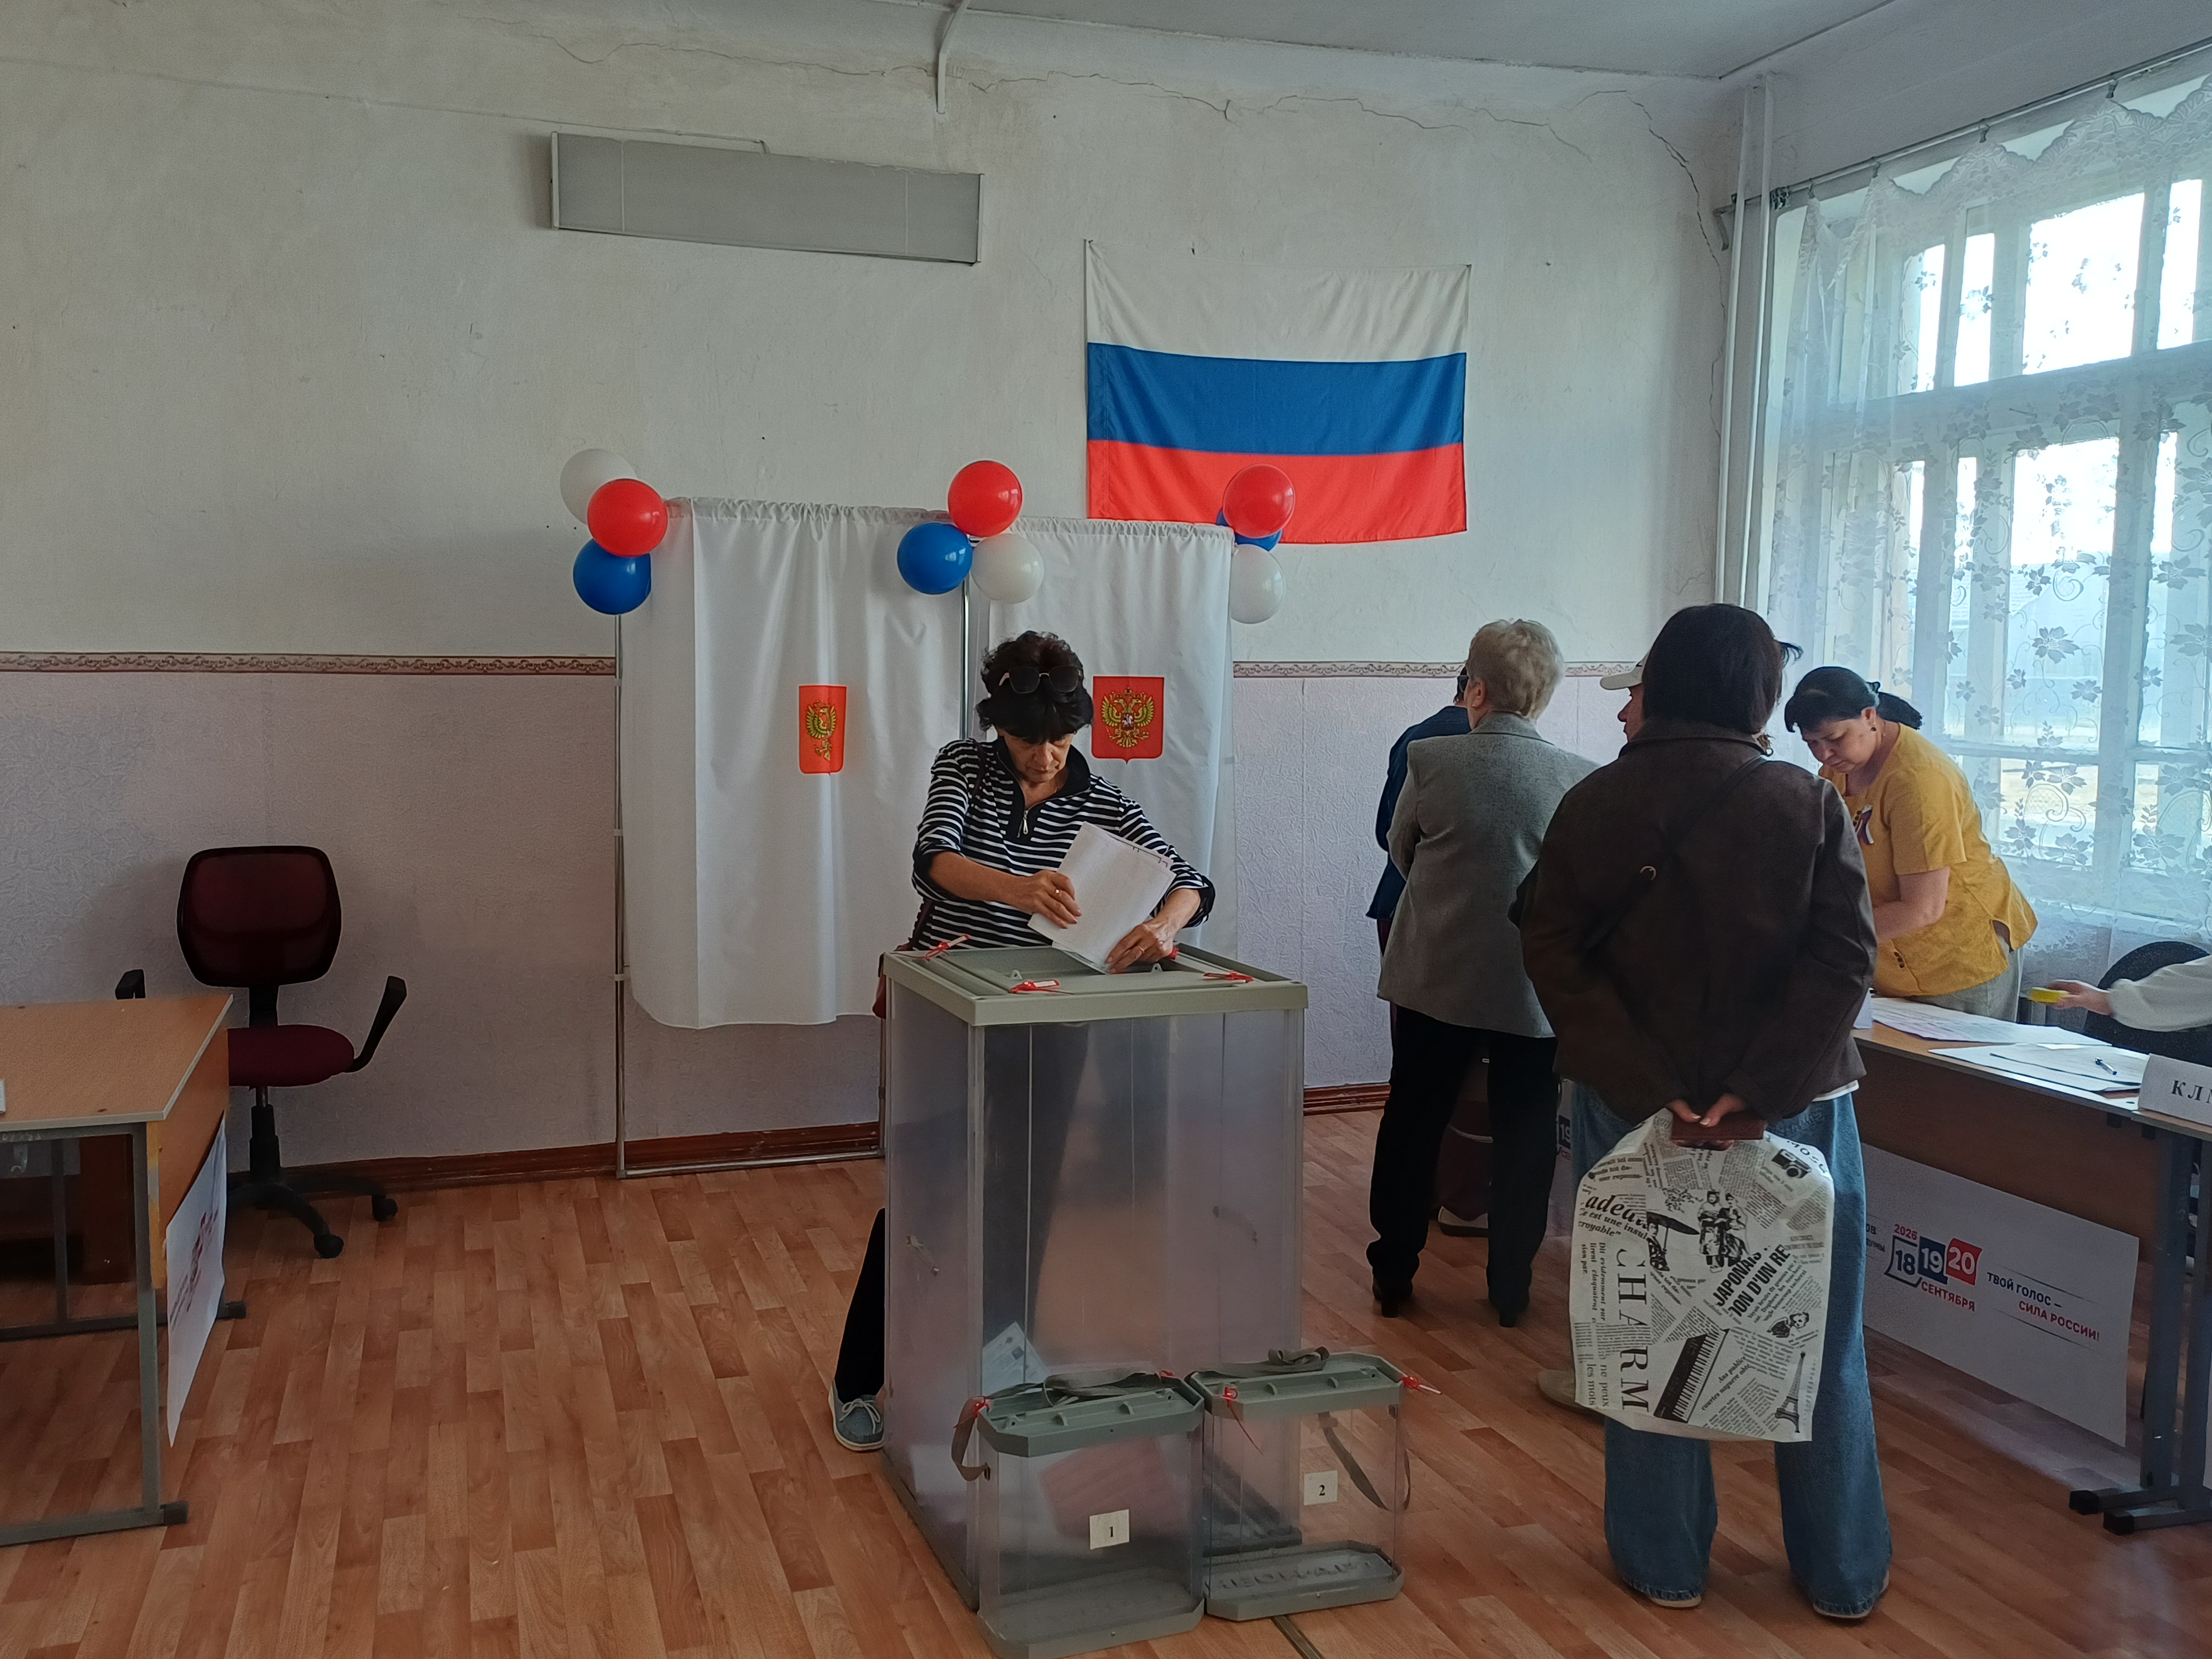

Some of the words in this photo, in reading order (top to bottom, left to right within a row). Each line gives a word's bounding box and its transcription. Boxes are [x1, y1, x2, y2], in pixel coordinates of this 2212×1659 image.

[1589, 1211, 1602, 1220] est
[1604, 1215, 1623, 1227] une
[1894, 1223, 1918, 1241] 2026
[1895, 1250, 1916, 1275] 18
[1921, 1248, 1943, 1274] 19
[1948, 1246, 1975, 1275] 20
[1746, 1261, 1777, 1296] D'UN
[1987, 1271, 2014, 1291] ТВОЙ
[2016, 1284, 2052, 1306] ГОЛОС
[1921, 1281, 1975, 1312] СЕНТЯБРЯ
[2019, 1300, 2048, 1321] СИЛА
[2051, 1312, 2100, 1342] РОССИИ!
[1587, 1364, 1597, 1378] les
[1600, 1365, 1607, 1378] ne
[1588, 1380, 1597, 1406] mots
[1318, 1484, 1326, 1496] 2
[1108, 1526, 1113, 1538] 1
